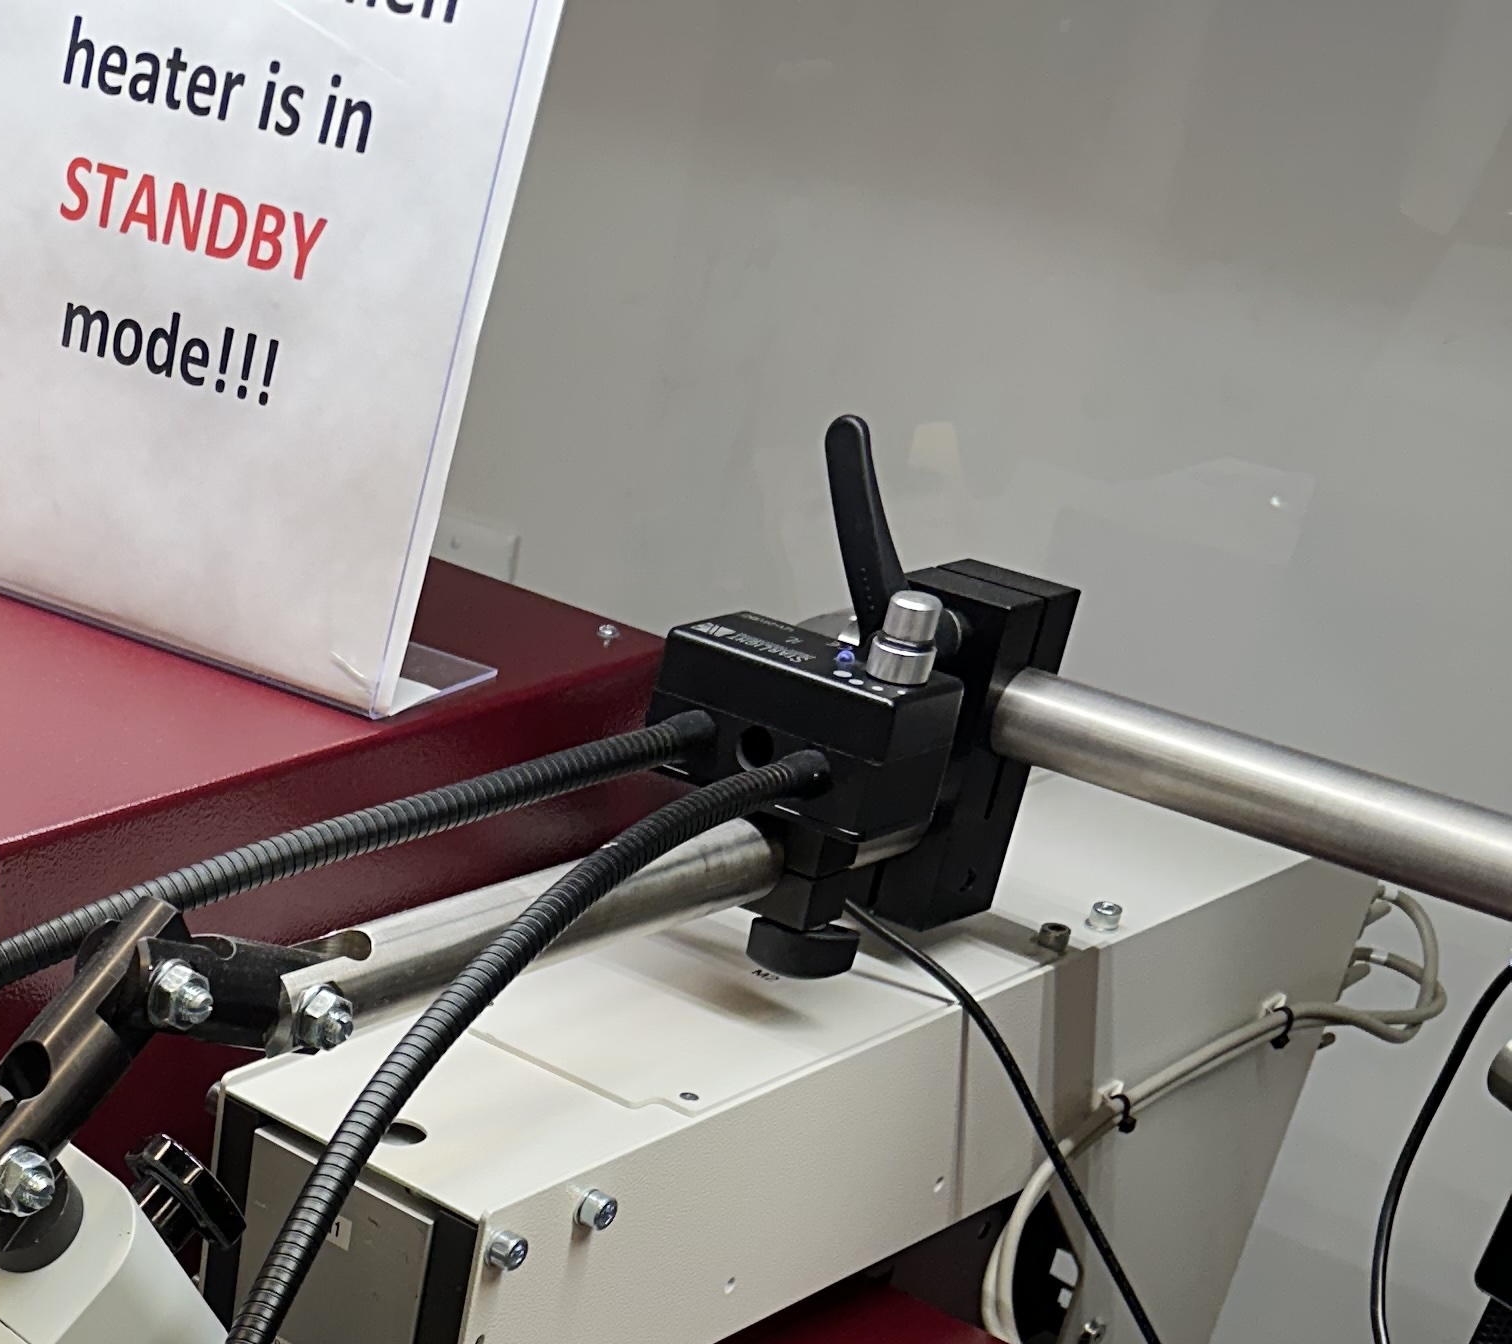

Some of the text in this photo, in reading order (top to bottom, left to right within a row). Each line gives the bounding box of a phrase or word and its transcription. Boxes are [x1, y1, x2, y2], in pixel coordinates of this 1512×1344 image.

[62, 15, 374, 154] heater is in
[59, 156, 328, 281] STANDBY
[61, 302, 280, 407] mode!!!
